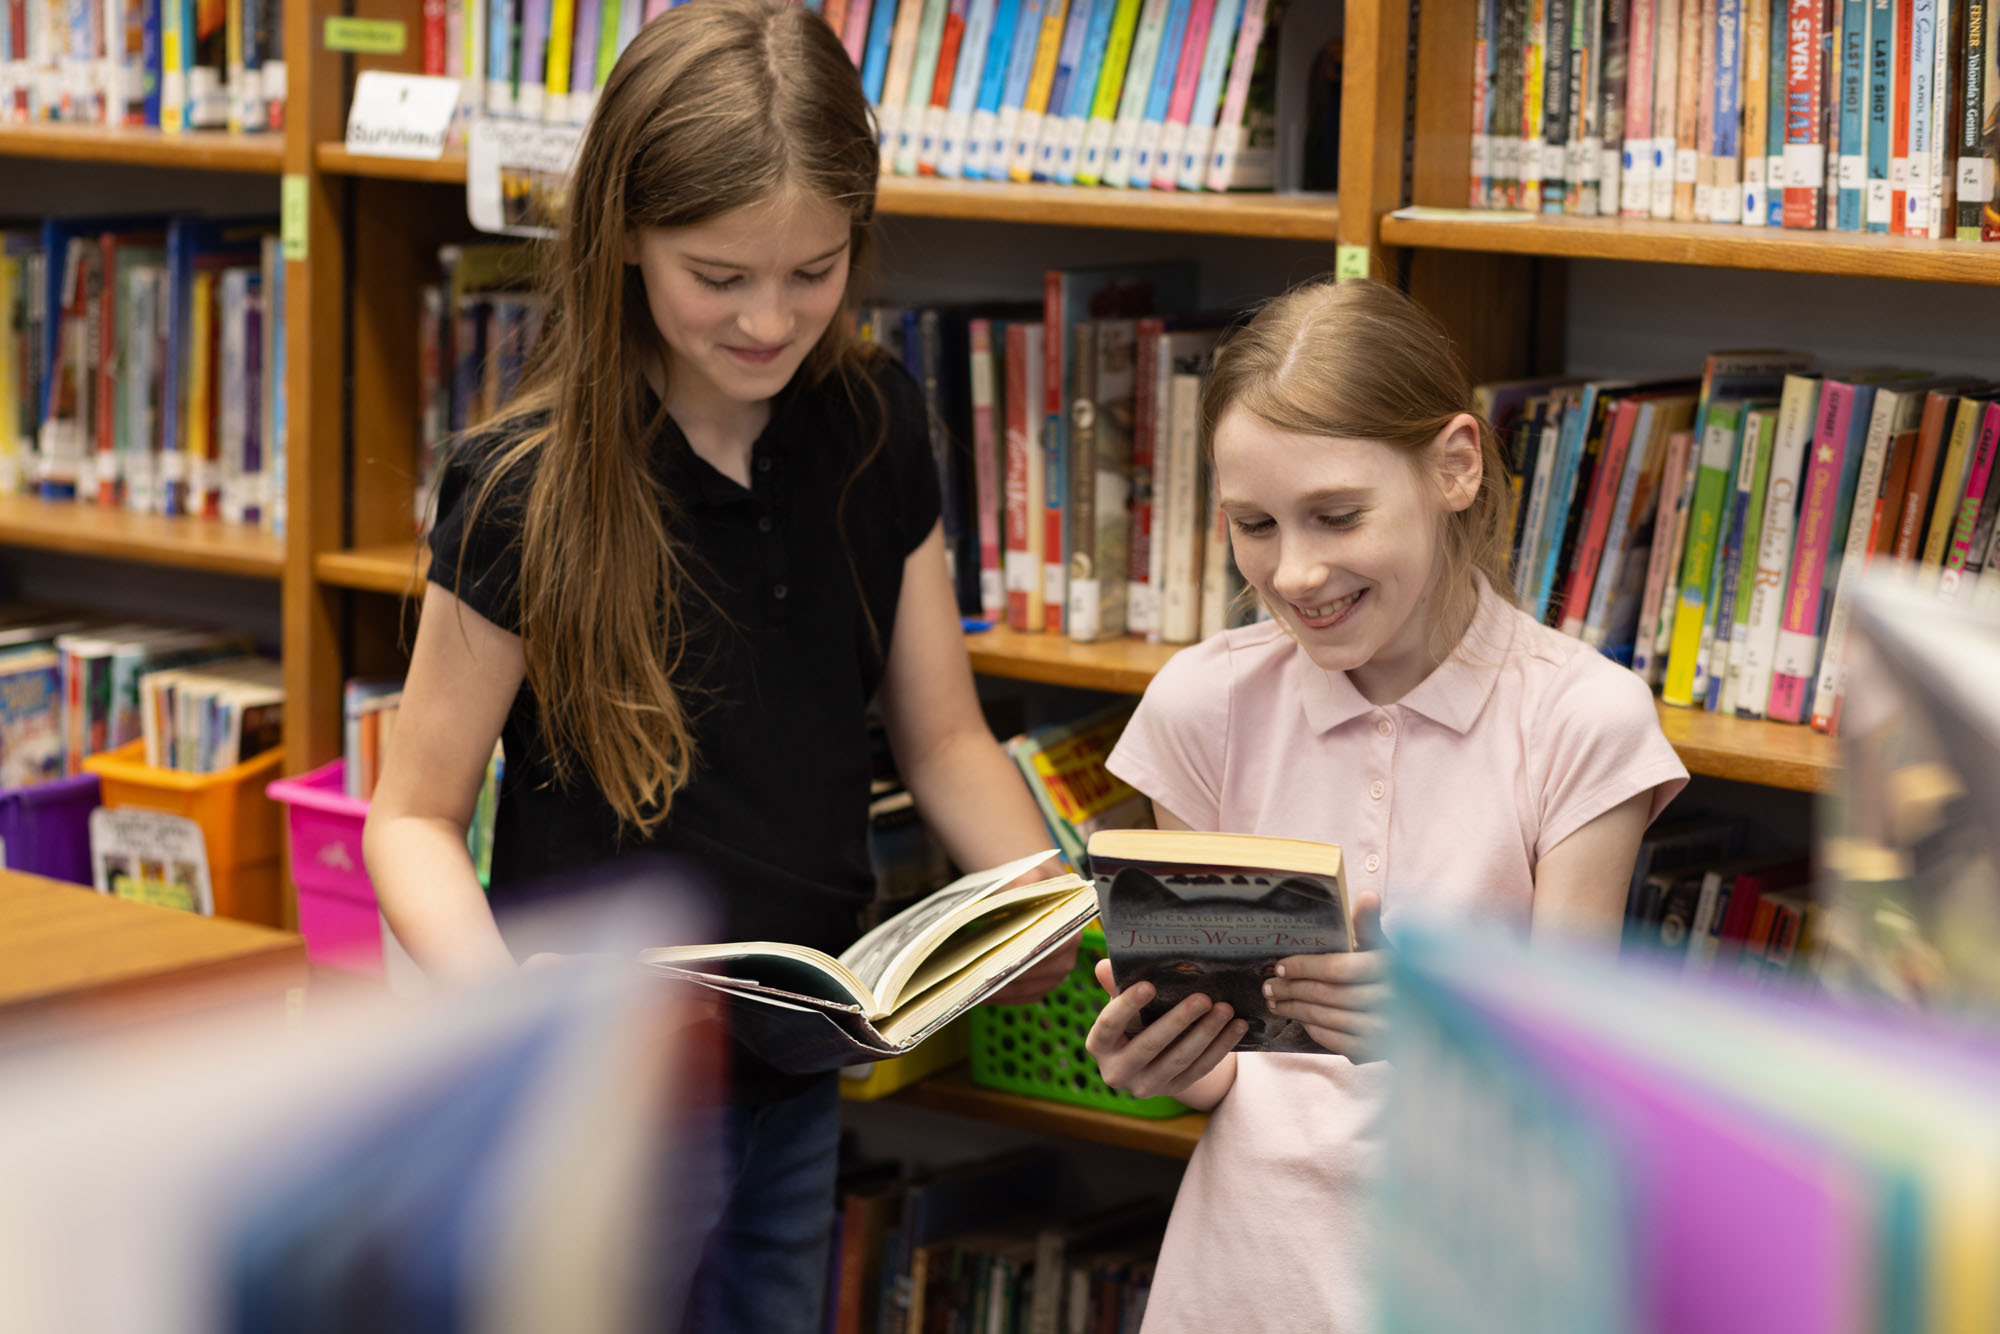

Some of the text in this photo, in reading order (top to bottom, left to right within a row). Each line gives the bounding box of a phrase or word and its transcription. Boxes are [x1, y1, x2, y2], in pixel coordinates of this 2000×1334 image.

[1968, 4, 1982, 48] FENNER
[1789, 18, 1811, 86] SEVEN,
[1874, 39, 1887, 79] LAST
[1846, 32, 1860, 115] LAST SHOT
[1914, 74, 1926, 115] CAROL
[1873, 84, 1886, 123] SHOT
[1965, 53, 1981, 148] Yolonda's Genius
[1978, 428, 1994, 470] GIFF
[1752, 477, 1793, 627] Charlie's Raven
[1120, 929, 1327, 949] JULIE'S WOLF PACK
[1166, 913, 1255, 923] CRAIGHEAD
